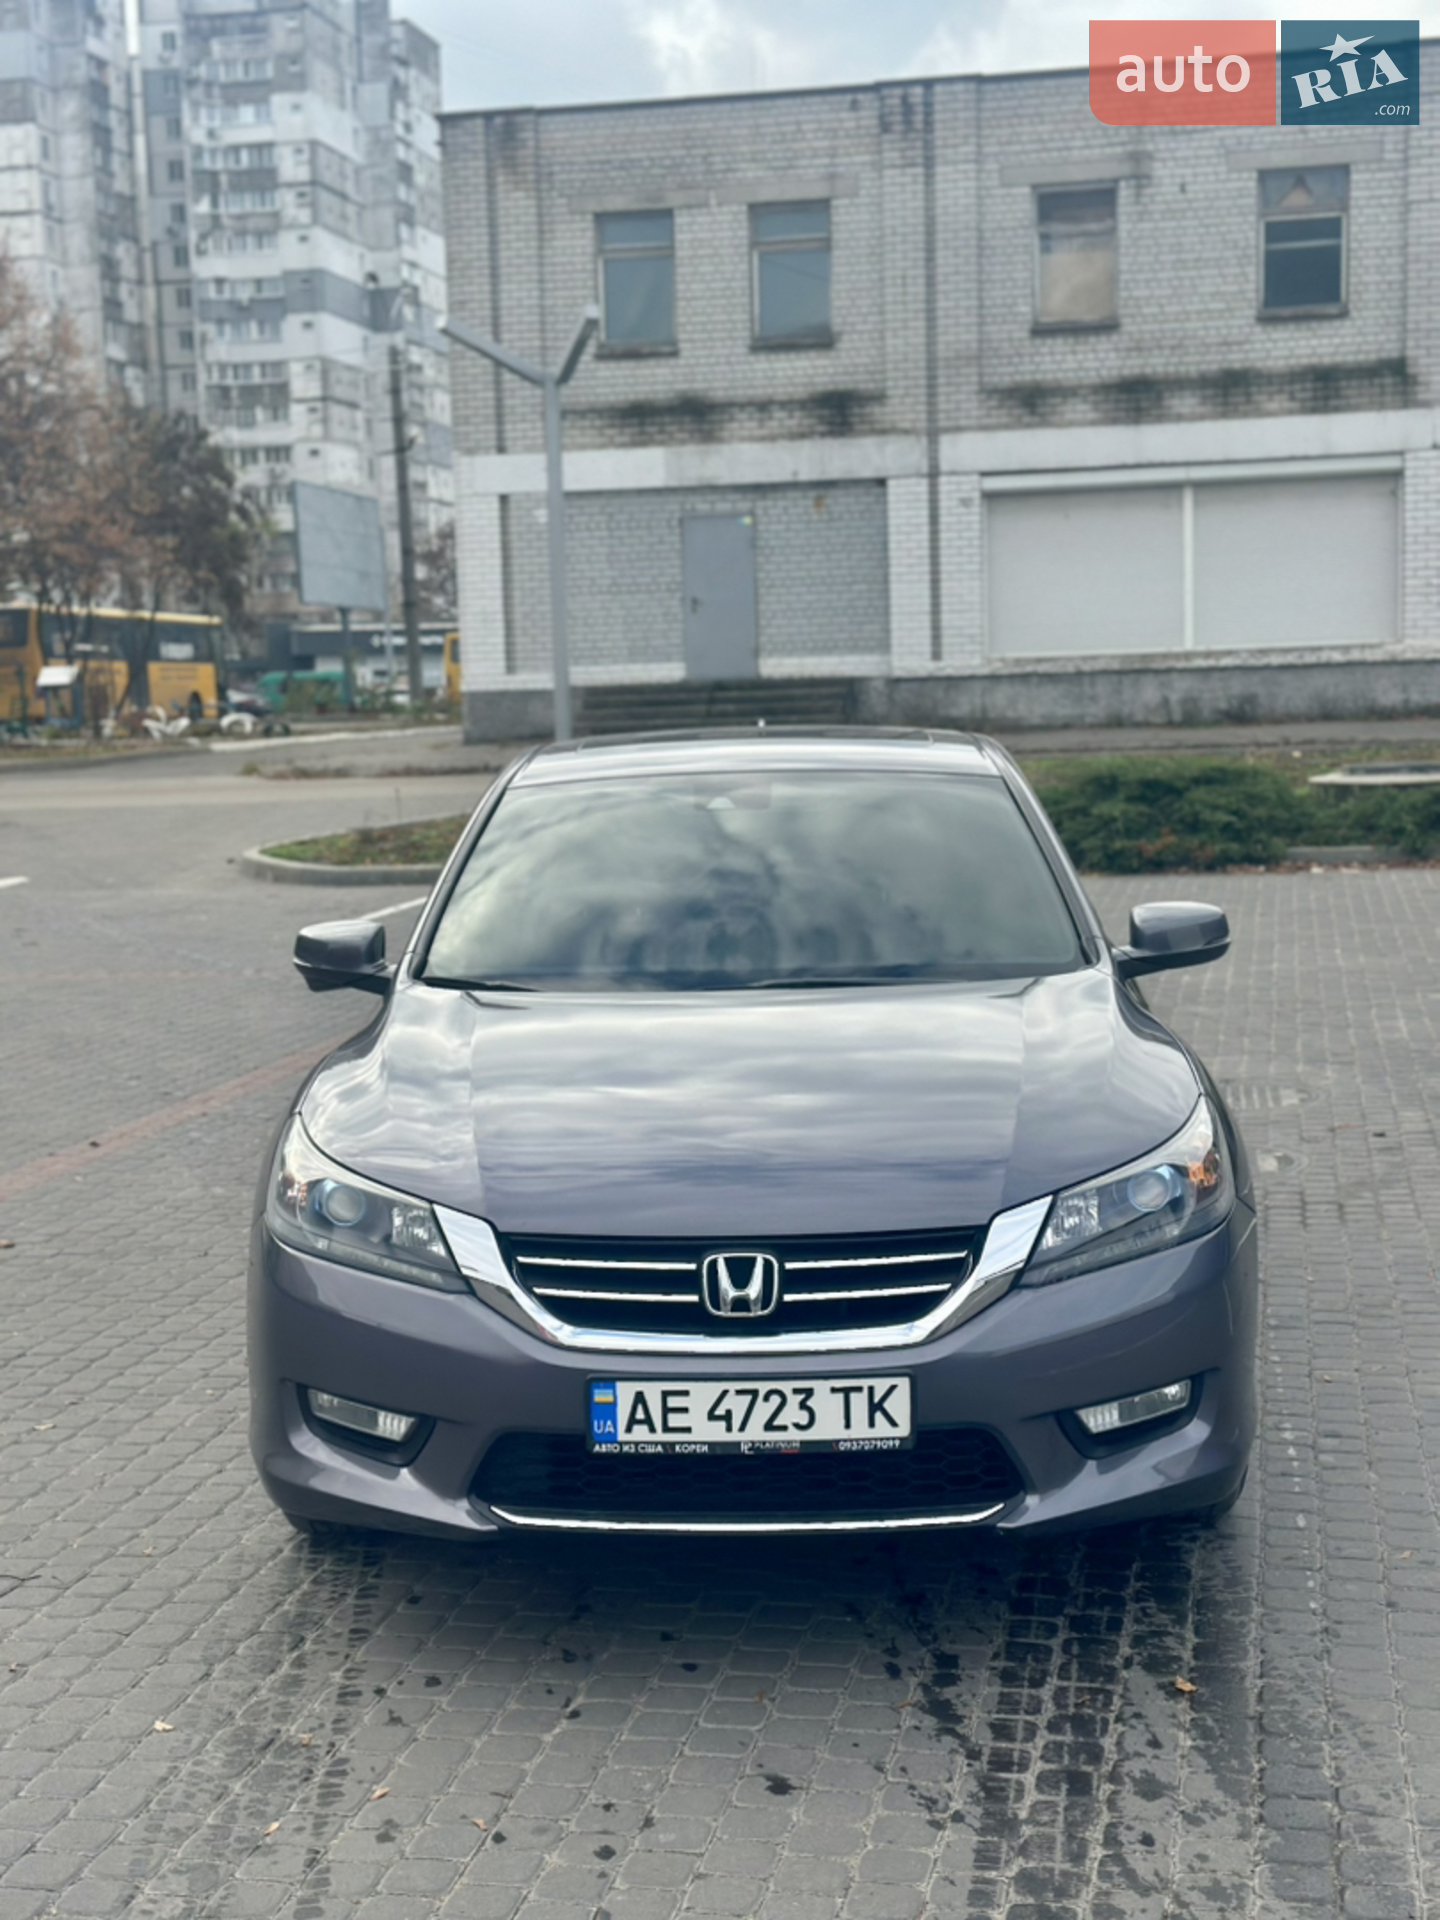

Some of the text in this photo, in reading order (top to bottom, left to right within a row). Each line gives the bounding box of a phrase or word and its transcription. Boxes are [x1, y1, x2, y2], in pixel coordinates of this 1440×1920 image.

[624, 1384, 900, 1434] AE 4723 TK
[593, 1419, 616, 1434] UA
[593, 1442, 621, 1454] АВТО
[637, 1442, 664, 1454] США
